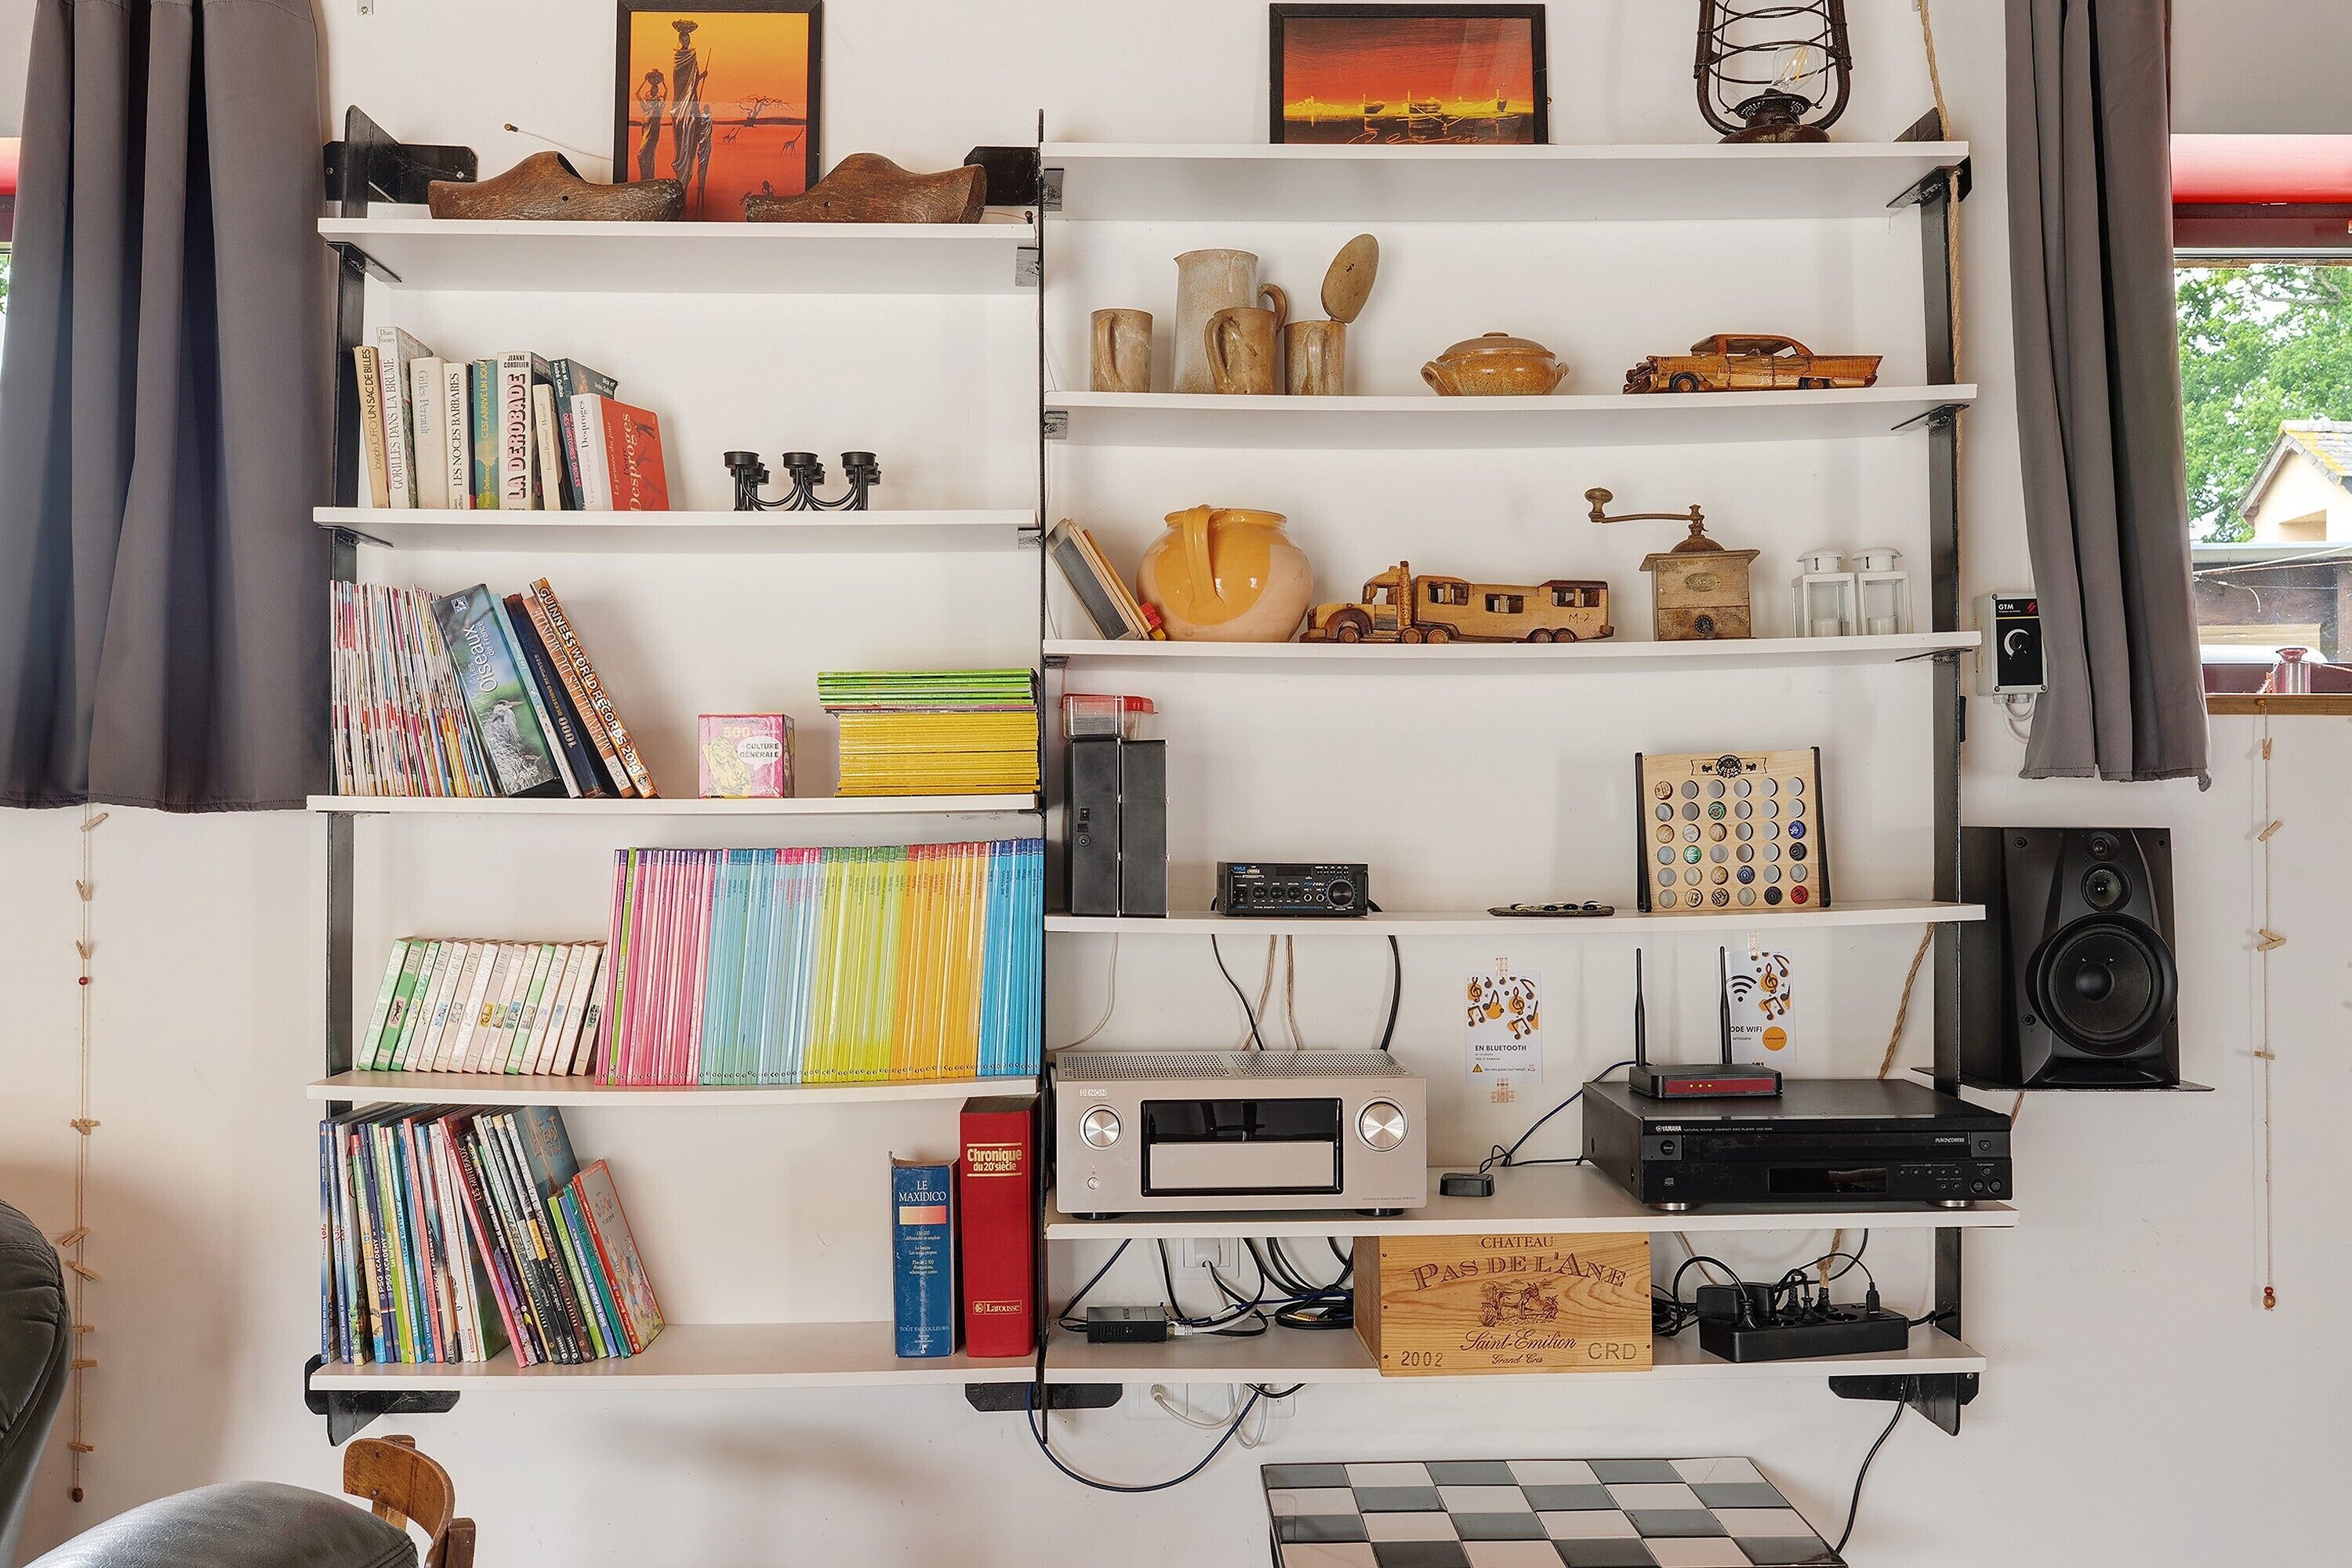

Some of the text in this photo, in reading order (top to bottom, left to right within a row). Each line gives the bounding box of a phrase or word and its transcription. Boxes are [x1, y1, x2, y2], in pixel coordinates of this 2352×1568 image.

[361, 348, 377, 419] UN SAC DE BILLES
[449, 372, 461, 425] BARBARES
[383, 358, 404, 489] GORILLES DANS LA BRUME
[507, 373, 526, 500] LA DEROBADE
[579, 401, 590, 448] Desproges
[451, 428, 463, 468] NOCES
[565, 426, 577, 460] HISTOIRES
[452, 469, 463, 487] LES
[622, 413, 643, 511] Desproges
[478, 621, 495, 656] de France
[463, 625, 498, 693] Oiseaux
[468, 662, 477, 681] Les
[531, 607, 612, 752] MERVEILLES DU MONDE
[539, 587, 643, 774] GUINNESS WORLD RECORDS 2014
[558, 717, 577, 749] 1000
[967, 1149, 1022, 1162] Chronique
[973, 1162, 983, 1171] du
[995, 1162, 1016, 1171] siècle
[471, 1185, 482, 1202] LES
[898, 1192, 946, 1202] MAXIDICO
[917, 1181, 927, 1190] LE
[380, 1238, 390, 1272] ACADEMY
[564, 1240, 575, 1267] enfants
[1481, 1236, 1554, 1249] CHATEAU
[372, 1239, 385, 1293] PSG ACADEMY
[572, 1268, 581, 1283] pour
[1408, 1252, 1628, 1292] PAS DE L'ANE
[575, 1240, 607, 1327] 500 BLAGUES pour enfants
[579, 1283, 590, 1312] BLAGUES
[986, 1303, 1020, 1312] Larousse
[1459, 1329, 1577, 1352] Saint-Emilion
[1588, 1342, 1638, 1361] CRD
[1401, 1352, 1444, 1367] 2002
[1491, 1353, 1544, 1364] Grand Cru
